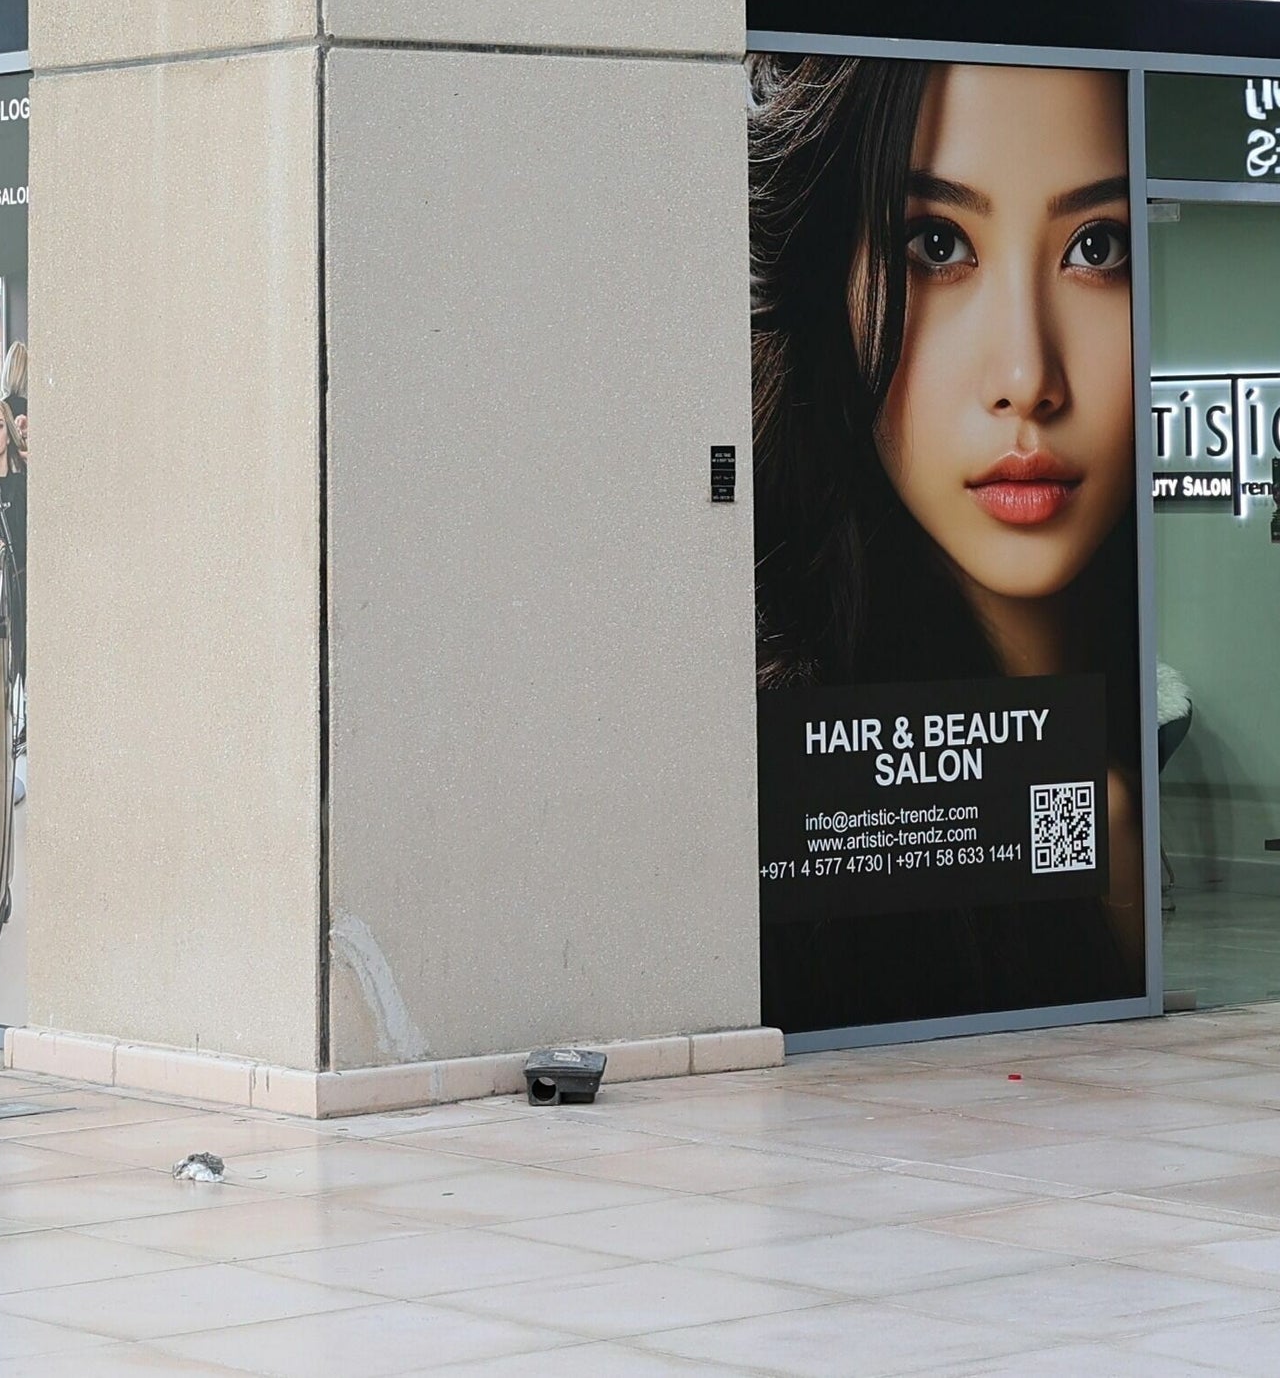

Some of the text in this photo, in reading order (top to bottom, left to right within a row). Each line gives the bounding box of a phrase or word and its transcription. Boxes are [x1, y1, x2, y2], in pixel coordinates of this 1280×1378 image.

[1182, 475, 1231, 497] SALON
[1241, 482, 1273, 495] ren
[806, 709, 1048, 754] HAIR & BEAUTY
[876, 748, 982, 786] SALON
[806, 805, 978, 832] info@artistic-trendz.com
[808, 828, 976, 852] www.artistic-trendz.com
[759, 844, 1020, 879] +971 4 577 4730 +971 58 633 1441
